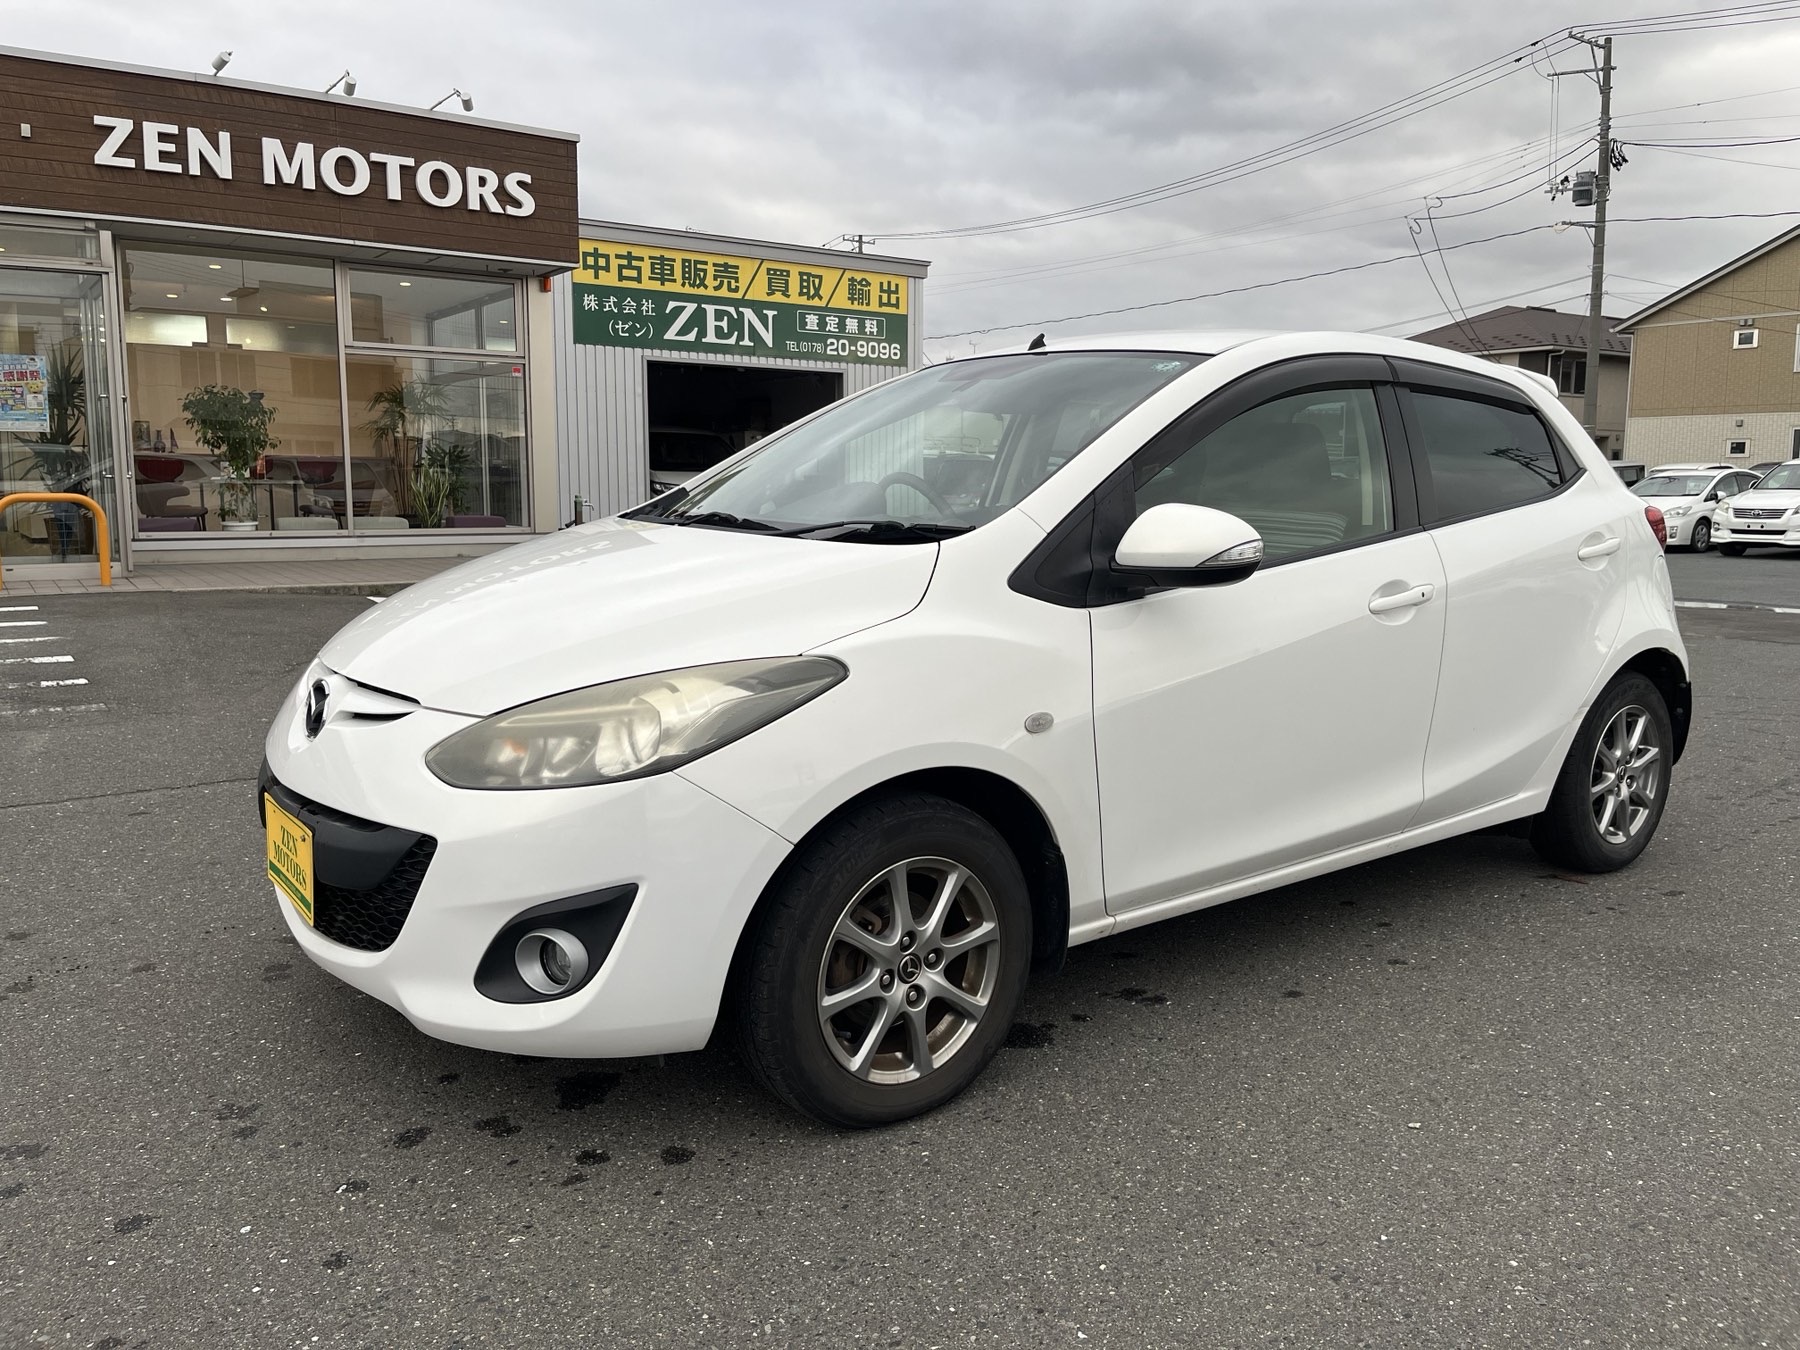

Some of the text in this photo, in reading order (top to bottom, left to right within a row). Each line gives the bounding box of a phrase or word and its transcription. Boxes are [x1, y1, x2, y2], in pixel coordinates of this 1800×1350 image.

[93, 115, 536, 218] ZEN MOTORS
[582, 247, 900, 310] 中古車販売 買取 輸出
[582, 293, 656, 316] 株式会社
[608, 319, 654, 339] (ゼン)
[663, 300, 778, 348] ZEN
[805, 313, 878, 336] 査定無料
[826, 338, 901, 360] 20-9096
[280, 825, 298, 858] ZEN
[272, 840, 307, 891] MOTORS
